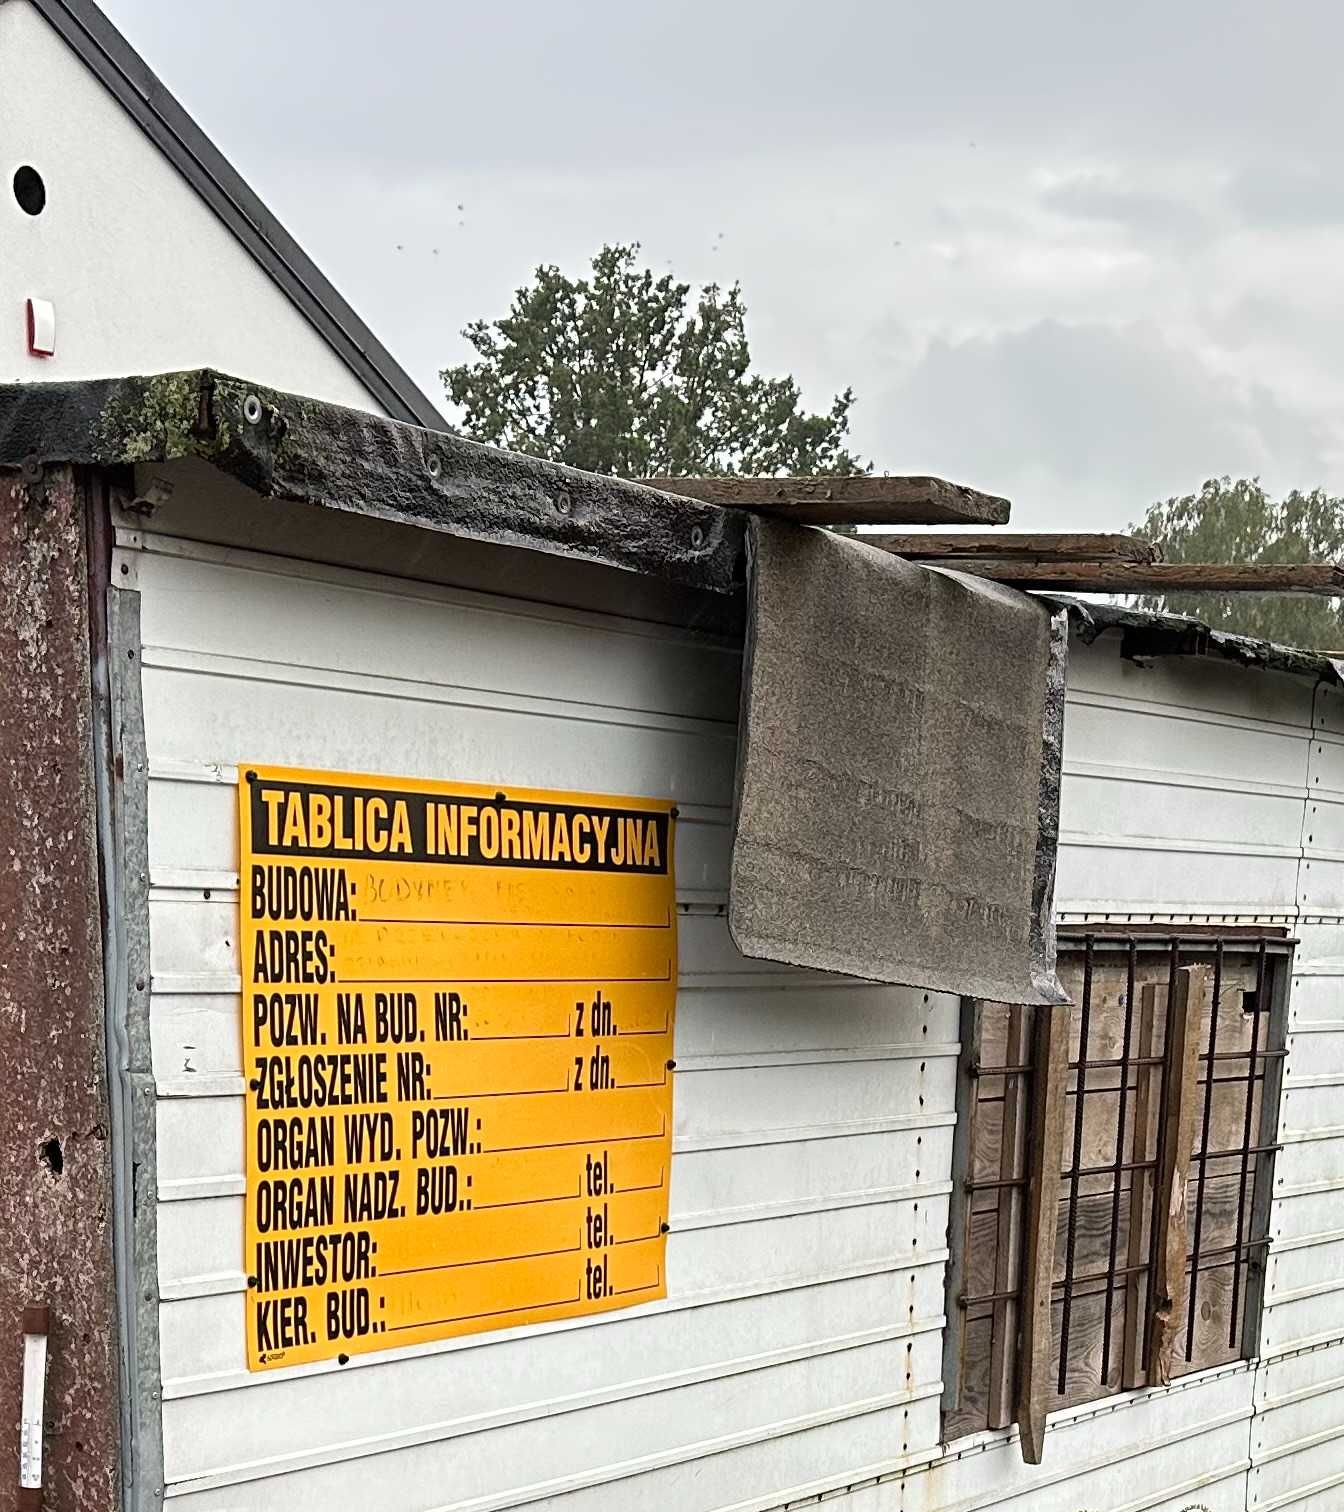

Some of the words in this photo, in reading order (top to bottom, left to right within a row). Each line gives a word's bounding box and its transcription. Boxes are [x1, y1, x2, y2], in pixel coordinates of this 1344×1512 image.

[262, 790, 413, 854] TABLICA
[427, 803, 660, 867] INFORMACYJNA
[252, 865, 356, 921] BUDOWA:
[254, 930, 335, 984] ADRES:
[254, 993, 326, 1047] POZW.
[337, 994, 367, 1044] NA
[375, 993, 424, 1043] BUD.
[435, 993, 468, 1041] NR:
[576, 1003, 584, 1036] z
[592, 991, 616, 1036] dn.
[256, 1053, 387, 1110] ZGŁOSZENIE
[397, 1052, 431, 1101] NR:
[574, 1057, 583, 1090] z
[590, 1045, 614, 1090] dn.
[258, 1116, 334, 1172] ORGAN
[344, 1113, 400, 1164] WYD.
[413, 1108, 481, 1157] POZW.:
[257, 1176, 333, 1233] ORGAN
[344, 1173, 405, 1223] NADZ.
[417, 1166, 471, 1215] BUD.:
[586, 1151, 613, 1196] tel.
[257, 1231, 376, 1292] INWESTOR:
[587, 1203, 613, 1248] tel.
[257, 1301, 316, 1352] KIER.
[586, 1254, 612, 1299] tel.
